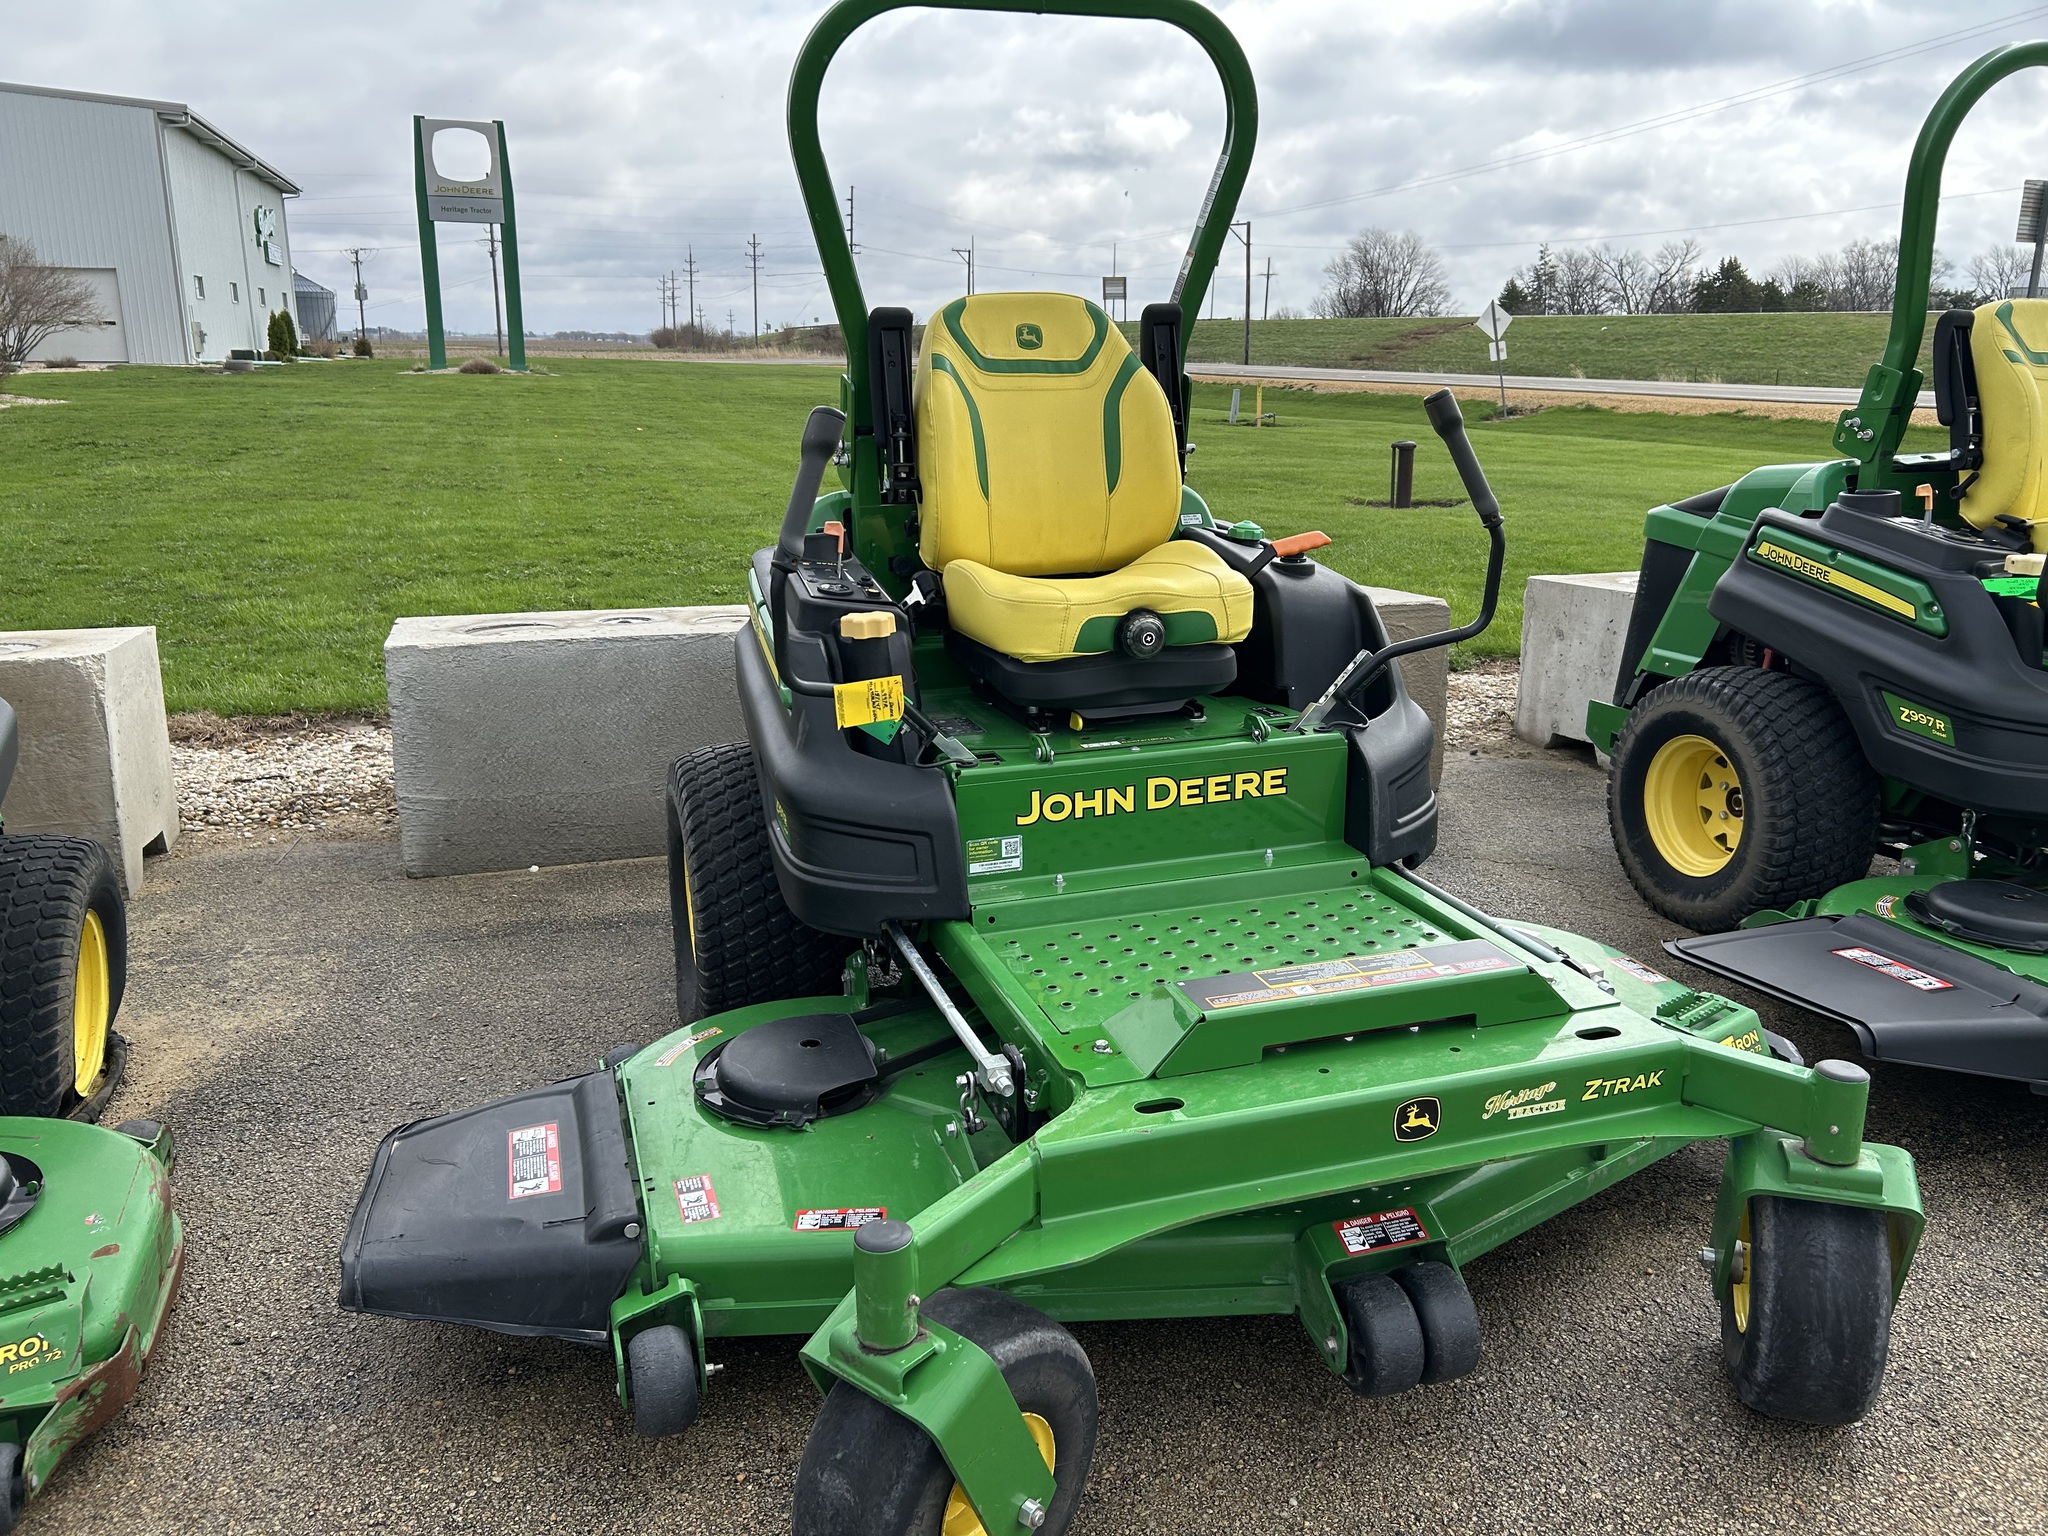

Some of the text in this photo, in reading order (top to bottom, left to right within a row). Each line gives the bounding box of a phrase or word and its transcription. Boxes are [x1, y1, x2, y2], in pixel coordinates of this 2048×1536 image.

[434, 185, 494, 195] JOHN DEERE
[441, 205, 492, 214] Heritage Tractor
[1763, 545, 1831, 582] JOHN DEERE
[1899, 706, 1946, 731] Z997R
[1015, 766, 1289, 826] JOHN DEERE
[1580, 1068, 1668, 1102] ZTRAK
[1482, 1081, 1557, 1120] Heritage
[1508, 1100, 1566, 1119] TRACTOR
[1349, 1216, 1373, 1227] DANGER
[1385, 1209, 1410, 1220] PELIGRO
[9, 1356, 40, 1374] PRO
[44, 1350, 62, 1363] 72
